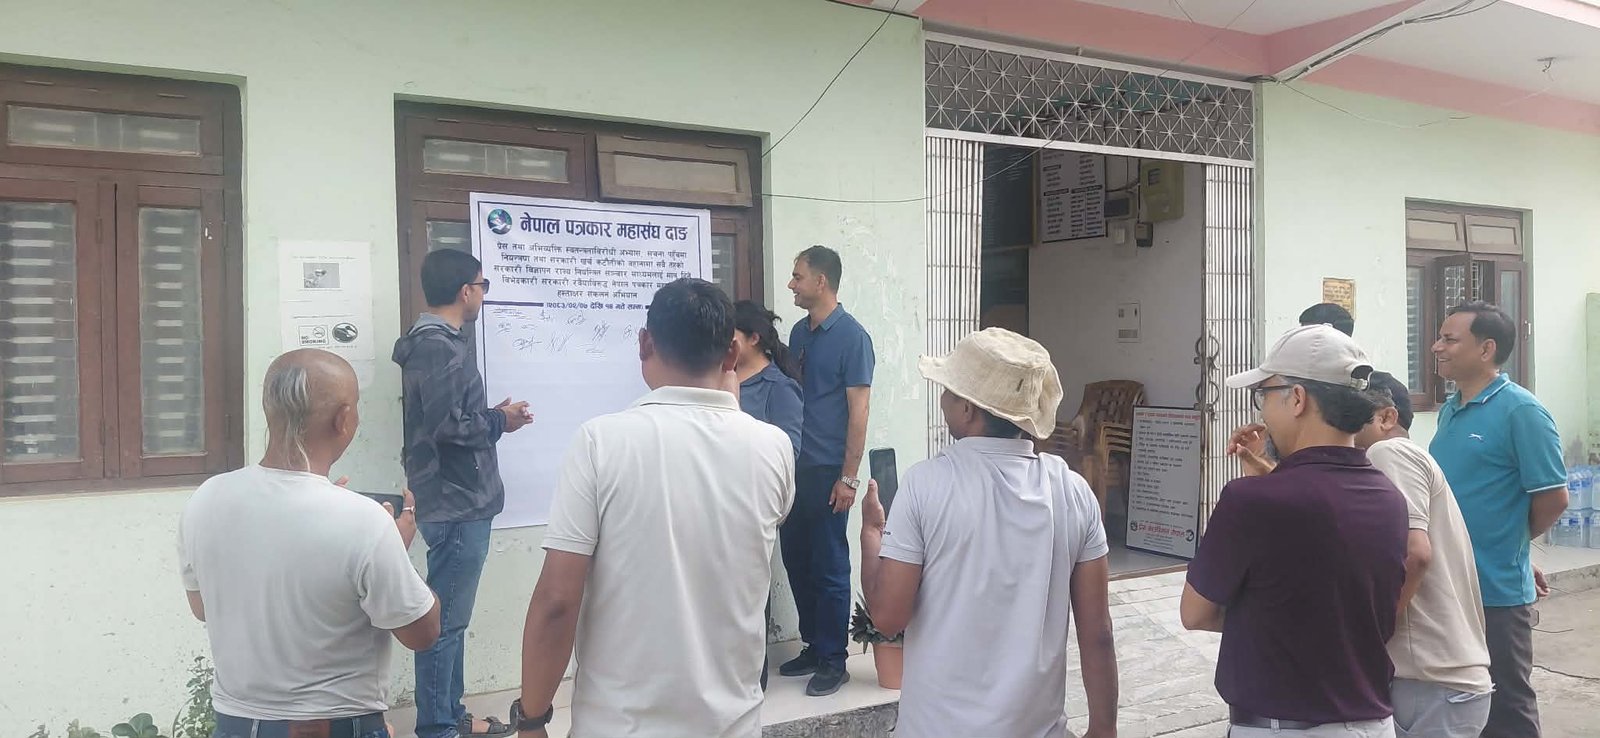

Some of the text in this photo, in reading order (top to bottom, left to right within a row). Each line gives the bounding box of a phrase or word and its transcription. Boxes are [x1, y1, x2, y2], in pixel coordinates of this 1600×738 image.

[520, 212, 688, 241] नेपाल पत्रकार महासंघ दाङ
[550, 256, 577, 264] सरकारी
[493, 264, 521, 273] सरकारी
[541, 277, 569, 286] सरकारी
[612, 280, 629, 288] नेपाल
